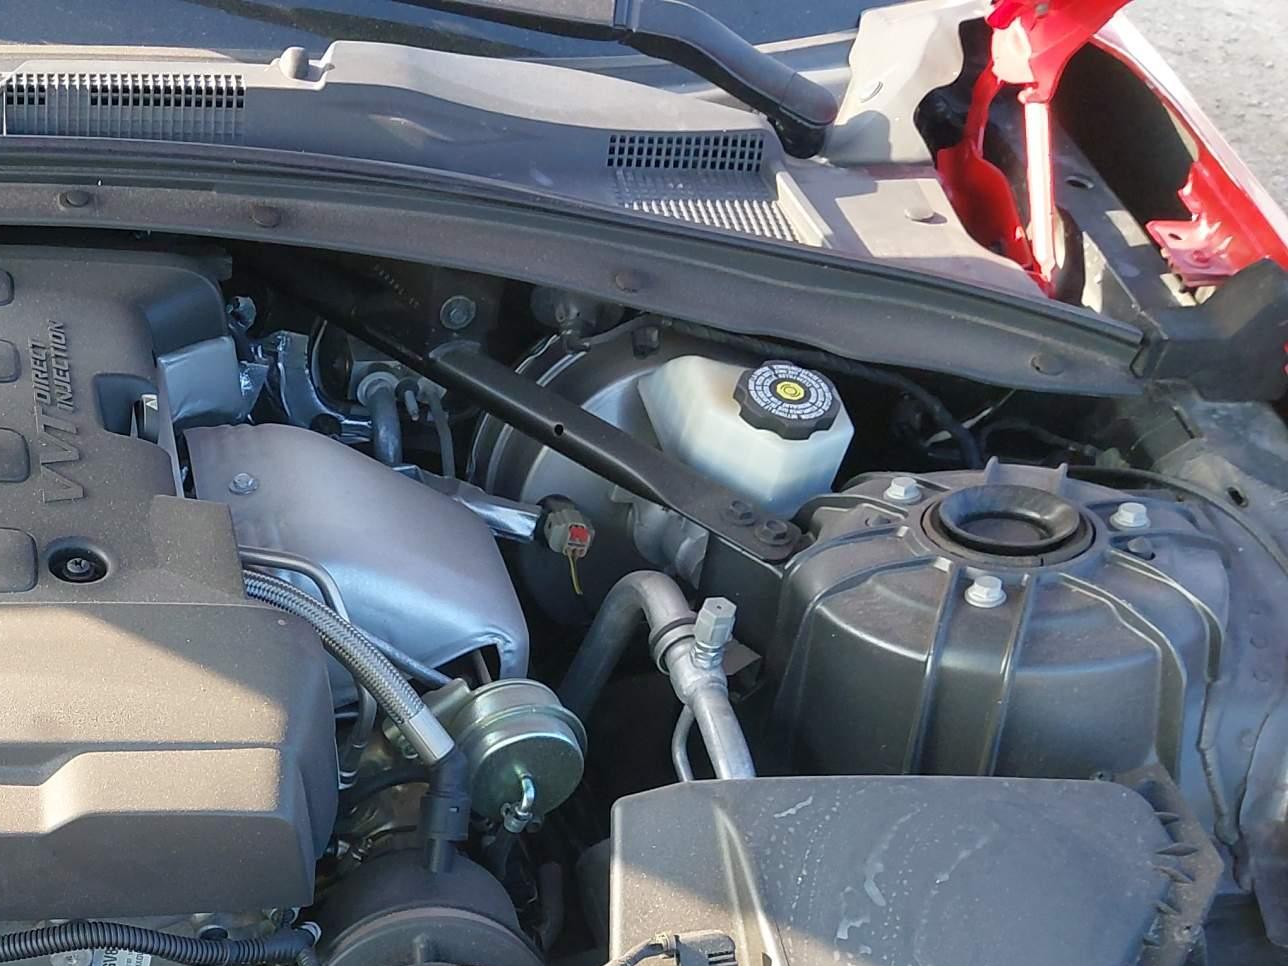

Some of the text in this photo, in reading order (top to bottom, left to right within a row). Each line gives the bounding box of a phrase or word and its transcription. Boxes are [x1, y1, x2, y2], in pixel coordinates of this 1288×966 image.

[28, 336, 51, 406] DIRECT
[48, 319, 75, 415] INJECTION
[34, 395, 85, 504] VVT
